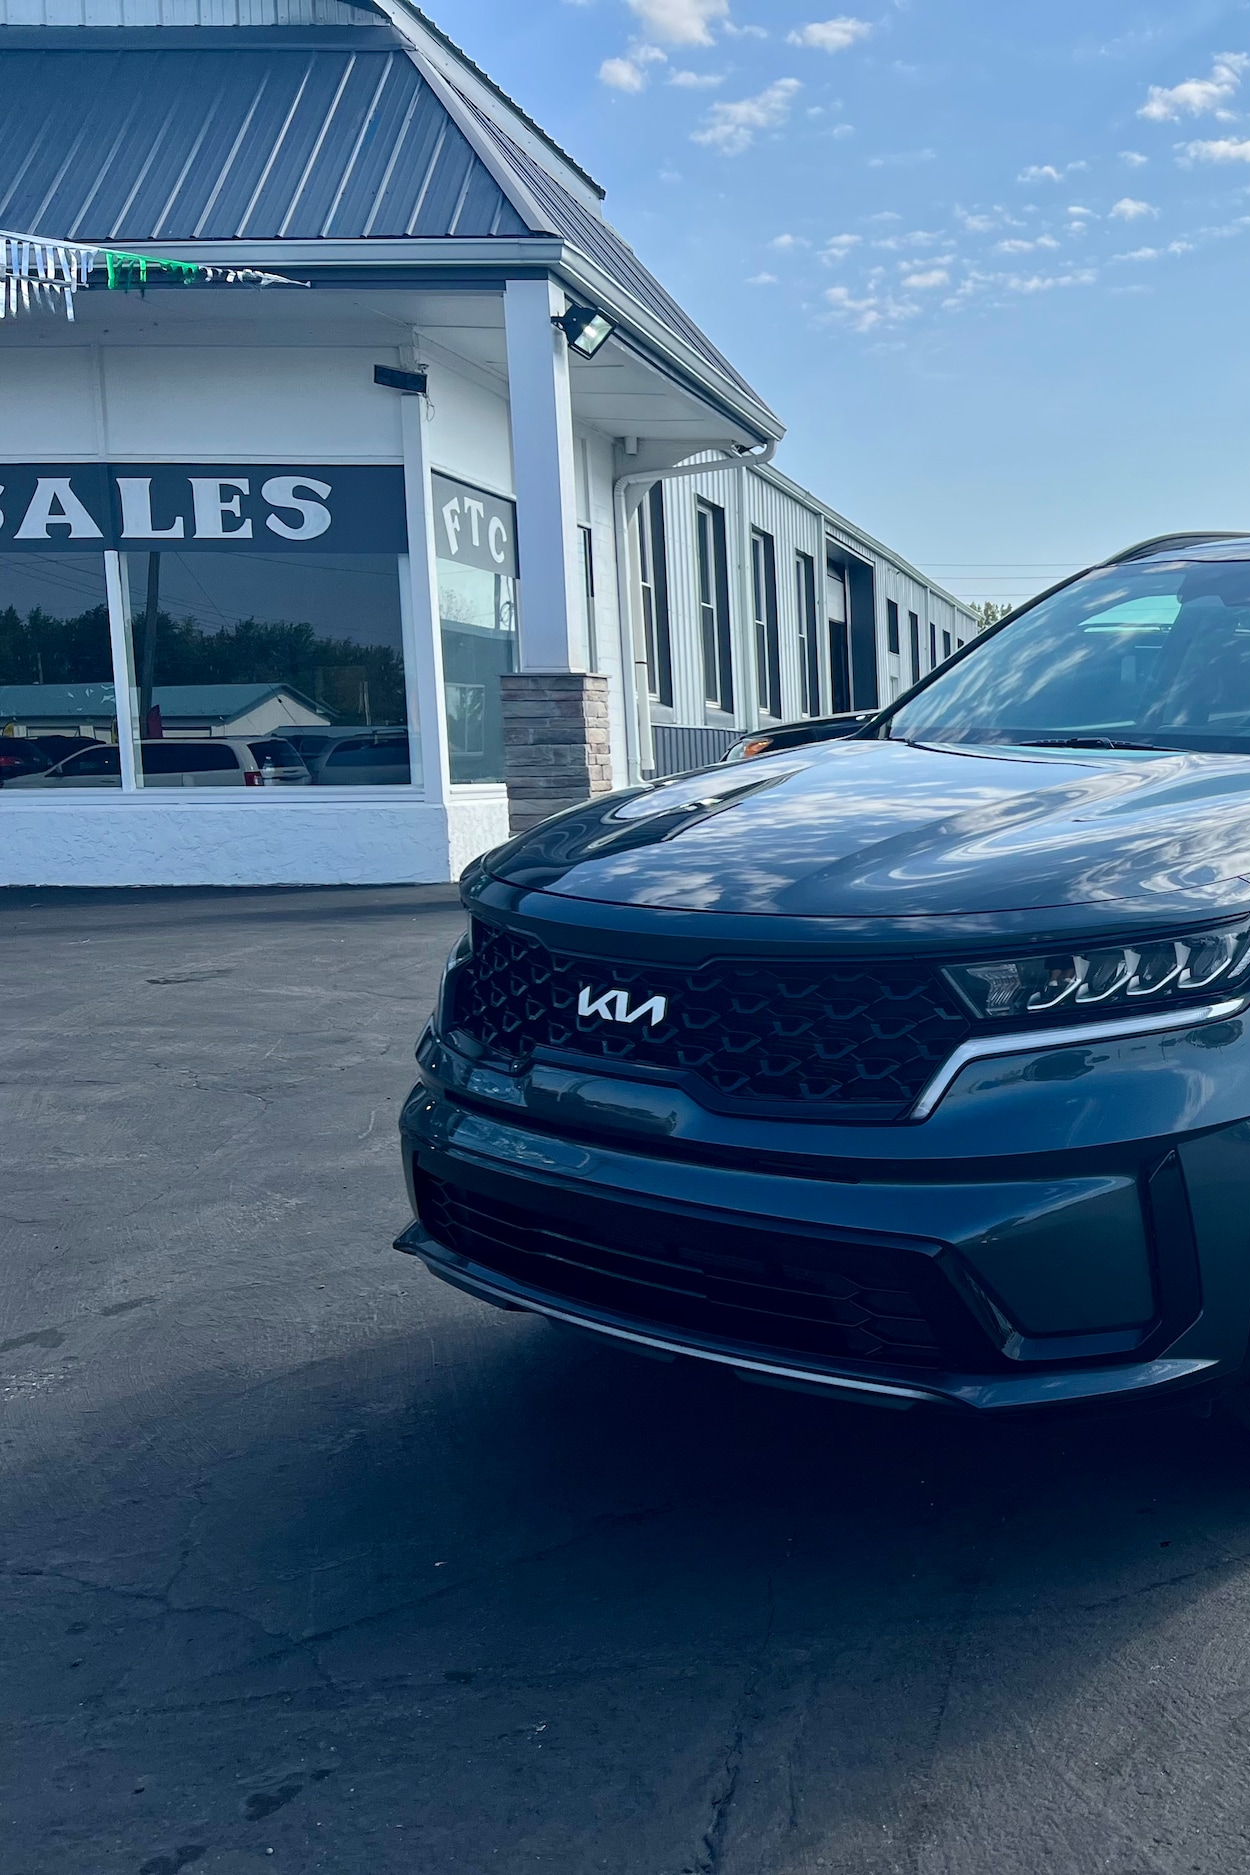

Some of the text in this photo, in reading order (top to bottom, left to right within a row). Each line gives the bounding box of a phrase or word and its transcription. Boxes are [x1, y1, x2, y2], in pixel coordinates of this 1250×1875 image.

[0, 476, 332, 541] ALES
[442, 496, 507, 563] FTC
[578, 986, 666, 1026] KIA
